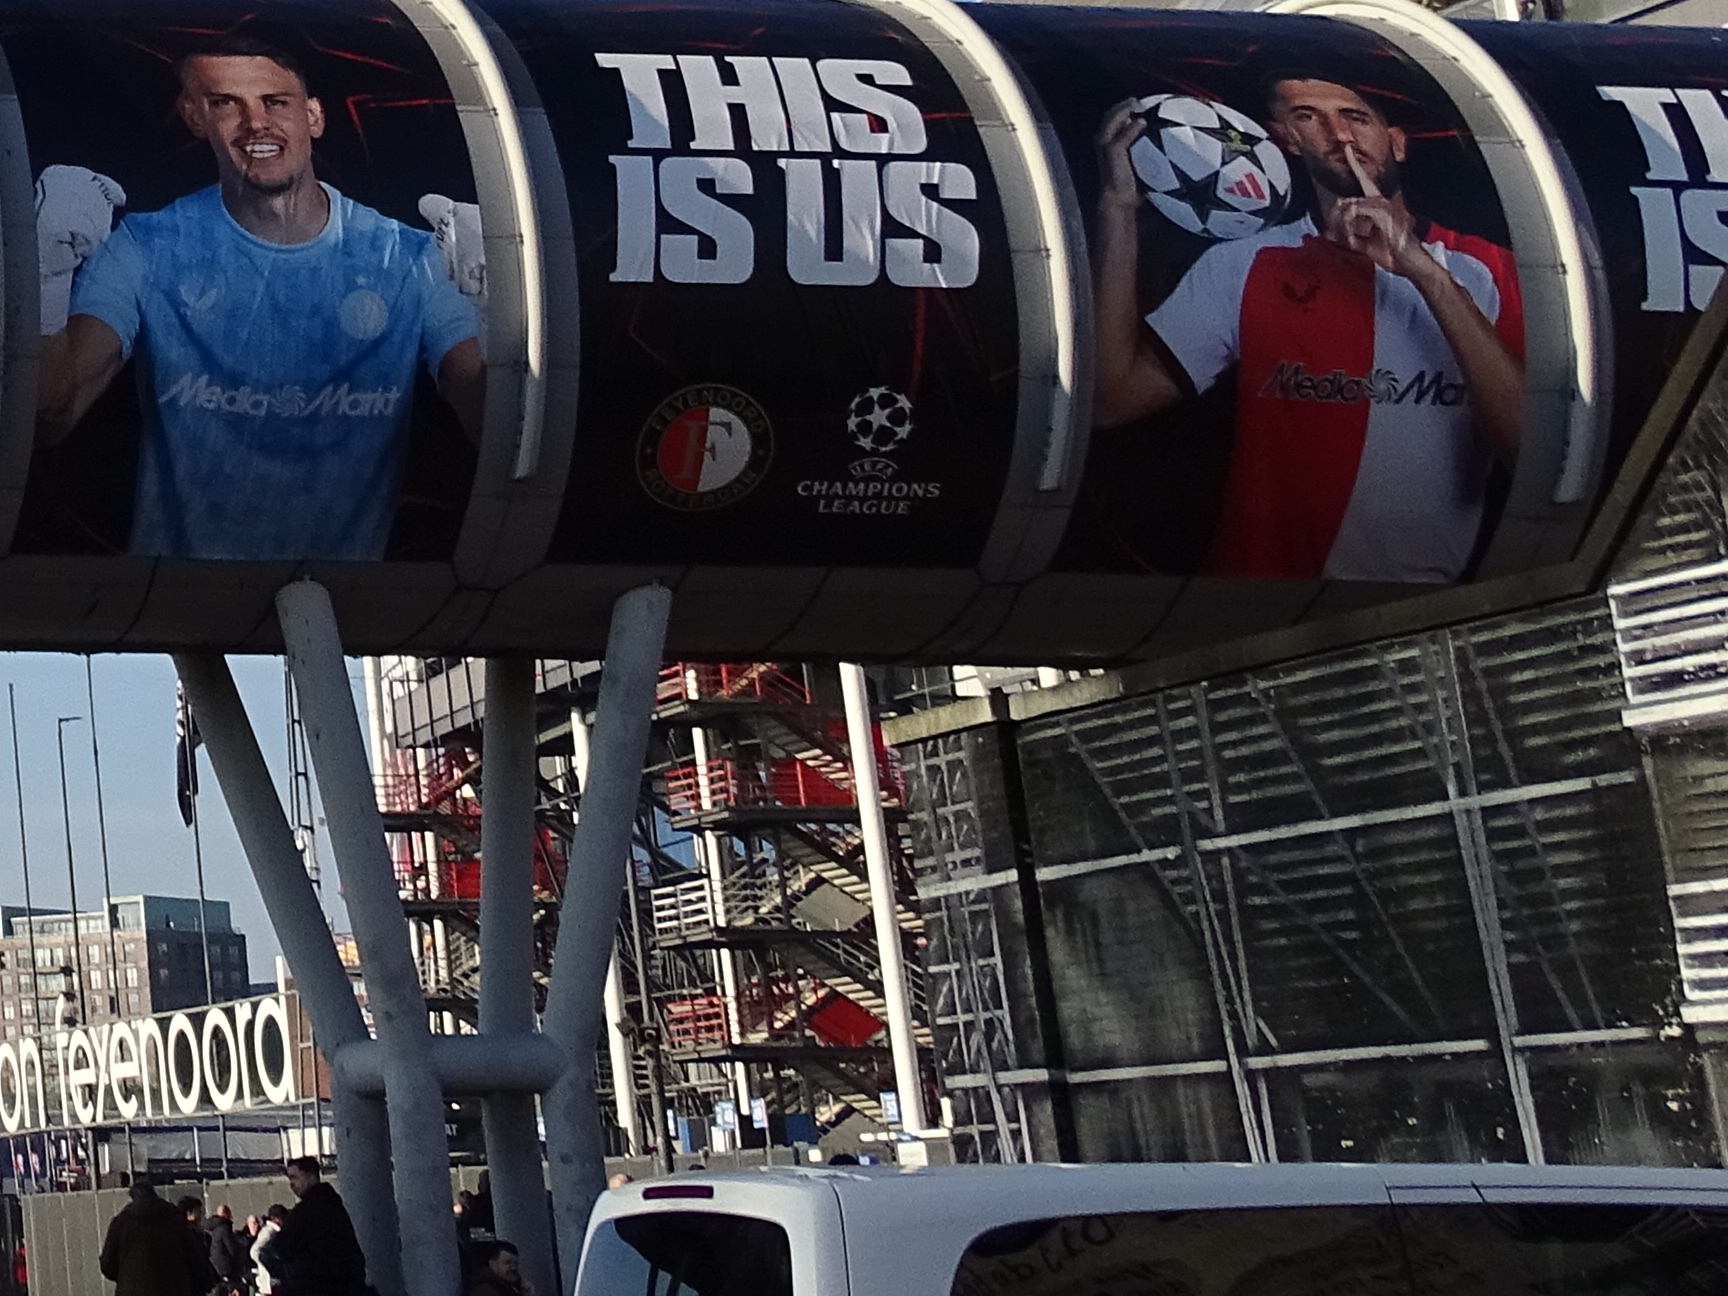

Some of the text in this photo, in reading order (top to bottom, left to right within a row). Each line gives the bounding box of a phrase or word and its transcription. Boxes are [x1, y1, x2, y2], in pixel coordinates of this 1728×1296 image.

[594, 53, 927, 154] THIS
[608, 155, 980, 288] IS US
[158, 372, 270, 417] Media
[1258, 361, 1368, 404] Media
[797, 481, 940, 499] CHAMPIONS
[849, 461, 894, 479] UEFA
[818, 499, 912, 515] LEAGUE
[55, 956, 296, 1127] feyenoord
